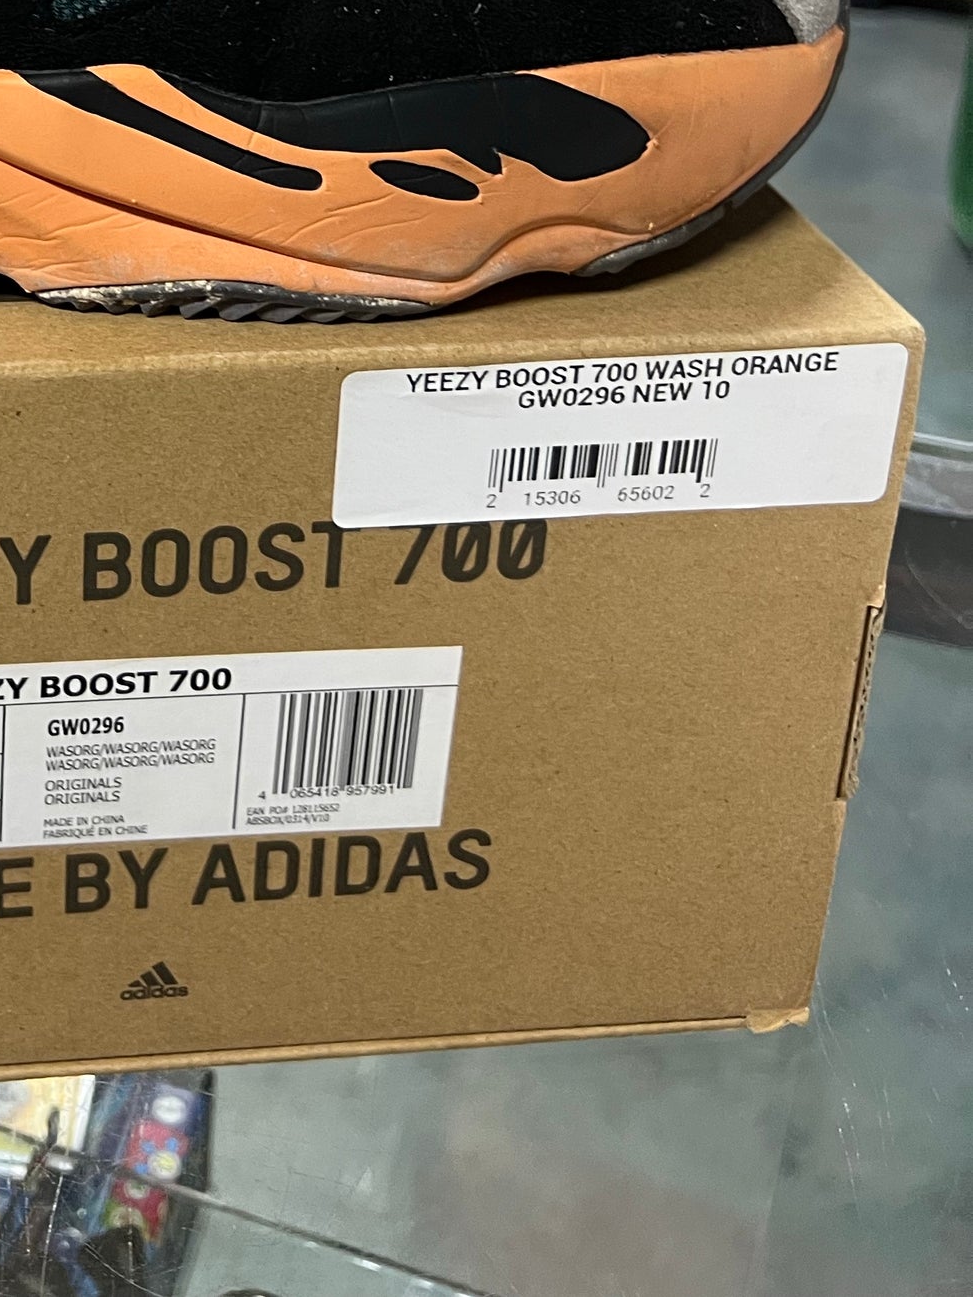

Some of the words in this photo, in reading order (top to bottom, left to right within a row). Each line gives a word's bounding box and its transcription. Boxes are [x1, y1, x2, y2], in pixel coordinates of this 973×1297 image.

[406, 370, 489, 393] YEEZY
[495, 365, 584, 389] BOOST
[591, 362, 638, 383] 700
[645, 358, 723, 381] WASH
[731, 351, 839, 376] ORANGE
[518, 385, 626, 409] GW0296
[632, 381, 693, 403] NEW
[702, 380, 731, 400] 10
[485, 493, 497, 509] 2
[523, 489, 581, 507] 15306
[617, 485, 675, 503] 65602
[699, 483, 711, 498] 2
[83, 521, 359, 601] BOOST
[387, 518, 547, 585] 700
[40, 671, 159, 699] BOOST
[169, 667, 233, 693] 700
[47, 716, 125, 737] GW0296
[44, 776, 123, 793] ORIGINALS
[44, 790, 122, 806] ORIGINALS
[43, 817, 74, 827] MADE
[77, 816, 89, 826] IN
[92, 814, 125, 824] CHINA
[65, 847, 169, 914] BY
[191, 828, 492, 906] ADIDAS
[120, 985, 189, 1001] adidas
